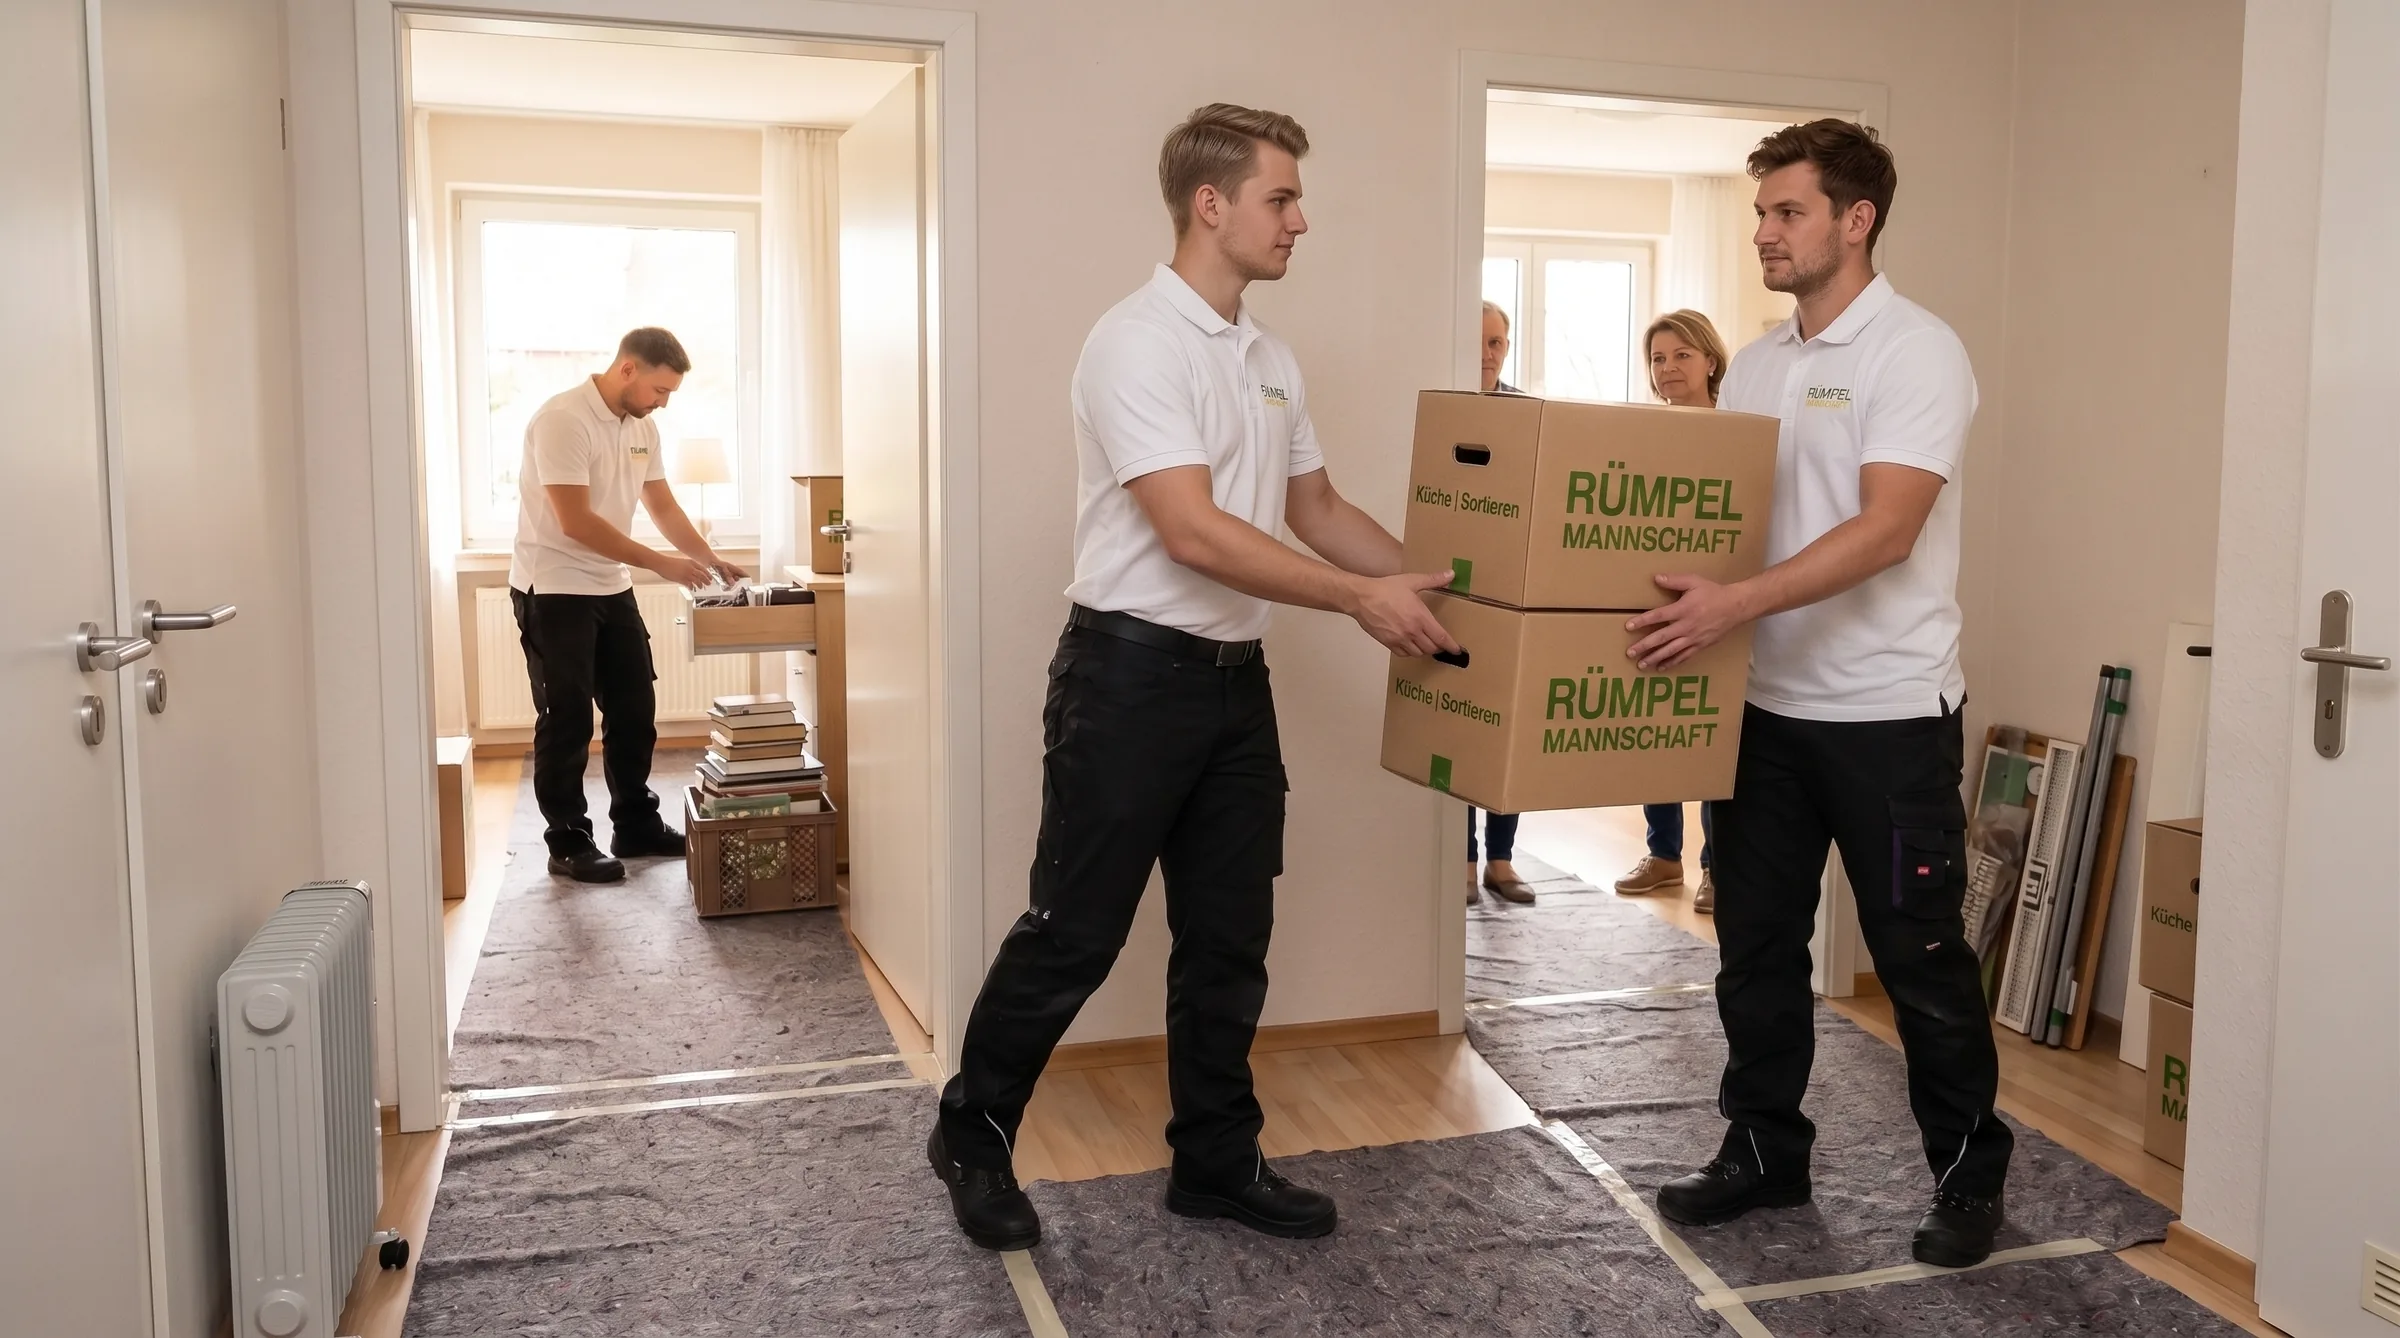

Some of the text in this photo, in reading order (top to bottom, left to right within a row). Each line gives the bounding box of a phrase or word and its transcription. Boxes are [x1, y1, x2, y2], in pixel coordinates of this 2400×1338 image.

[1416, 485, 1452, 507] Küche
[1460, 492, 1520, 519] Sortieren
[1566, 460, 1743, 521] RÜMPEL
[1562, 522, 1742, 554] MANNSCHAFT
[1395, 677, 1433, 705] Küche
[1441, 692, 1501, 727] Sortieren
[1546, 666, 1720, 720] RÜMPEL
[1542, 723, 1718, 753] MANNSCHAFT
[2151, 905, 2193, 933] Küche
